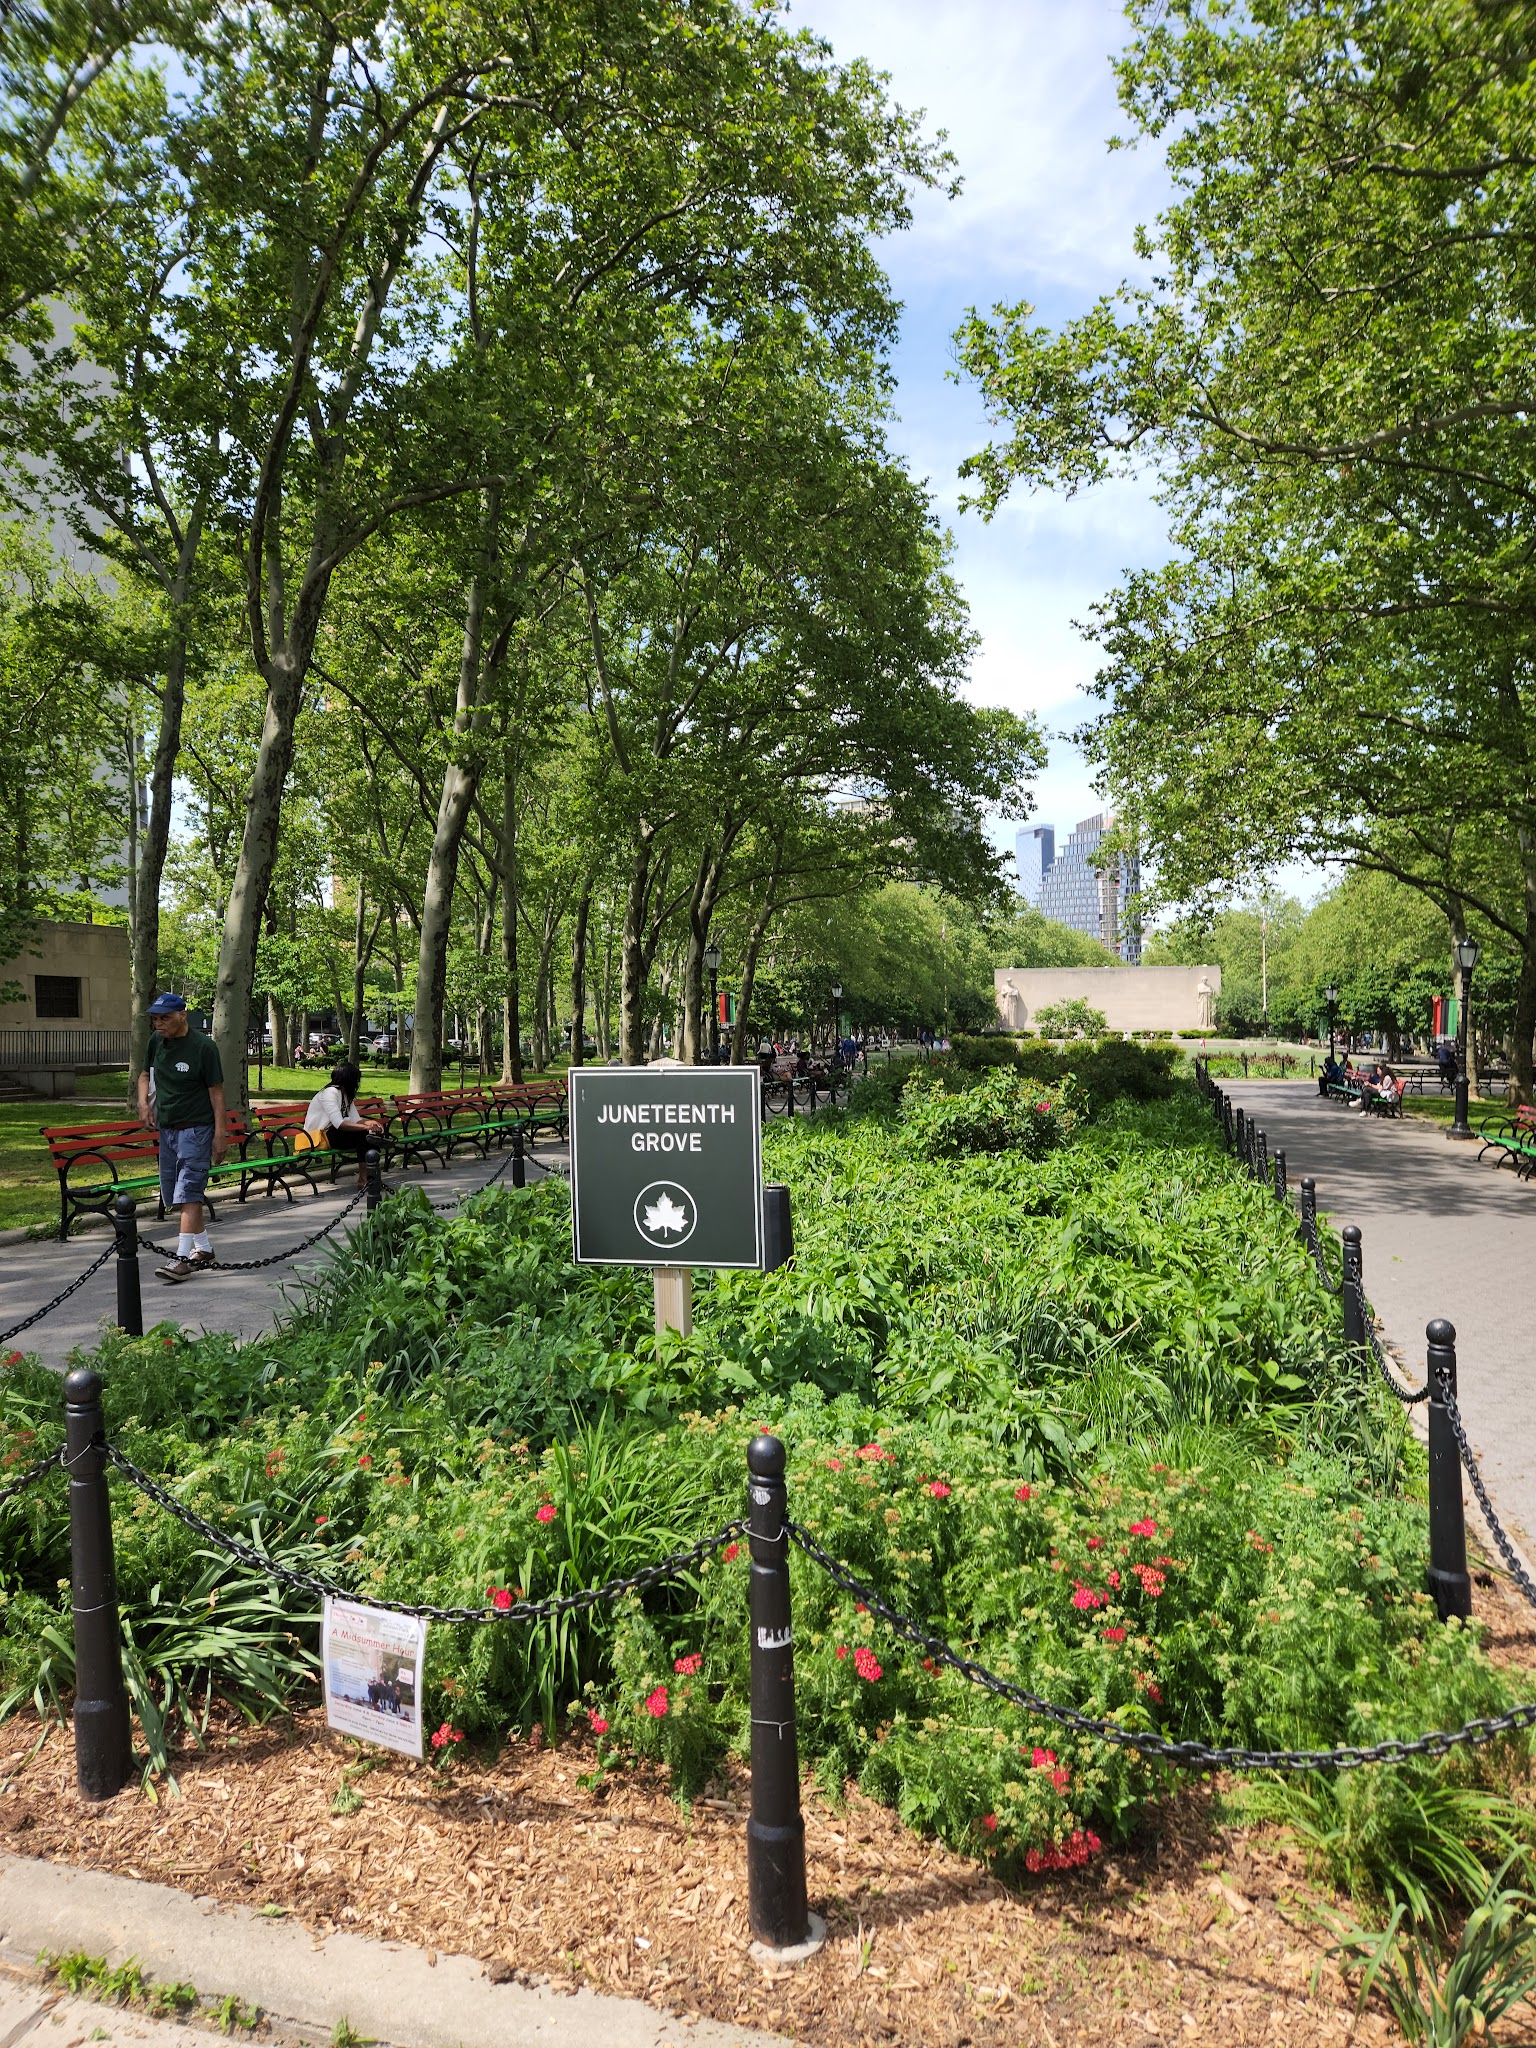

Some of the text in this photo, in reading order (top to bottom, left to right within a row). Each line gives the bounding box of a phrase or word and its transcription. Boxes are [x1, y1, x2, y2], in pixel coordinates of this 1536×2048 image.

[597, 1104, 735, 1124] JUNETEENTH
[631, 1132, 702, 1152] GROVE
[331, 1628, 338, 1636] A
[341, 1630, 391, 1650] Midsummer
[392, 1644, 415, 1657] Hour
